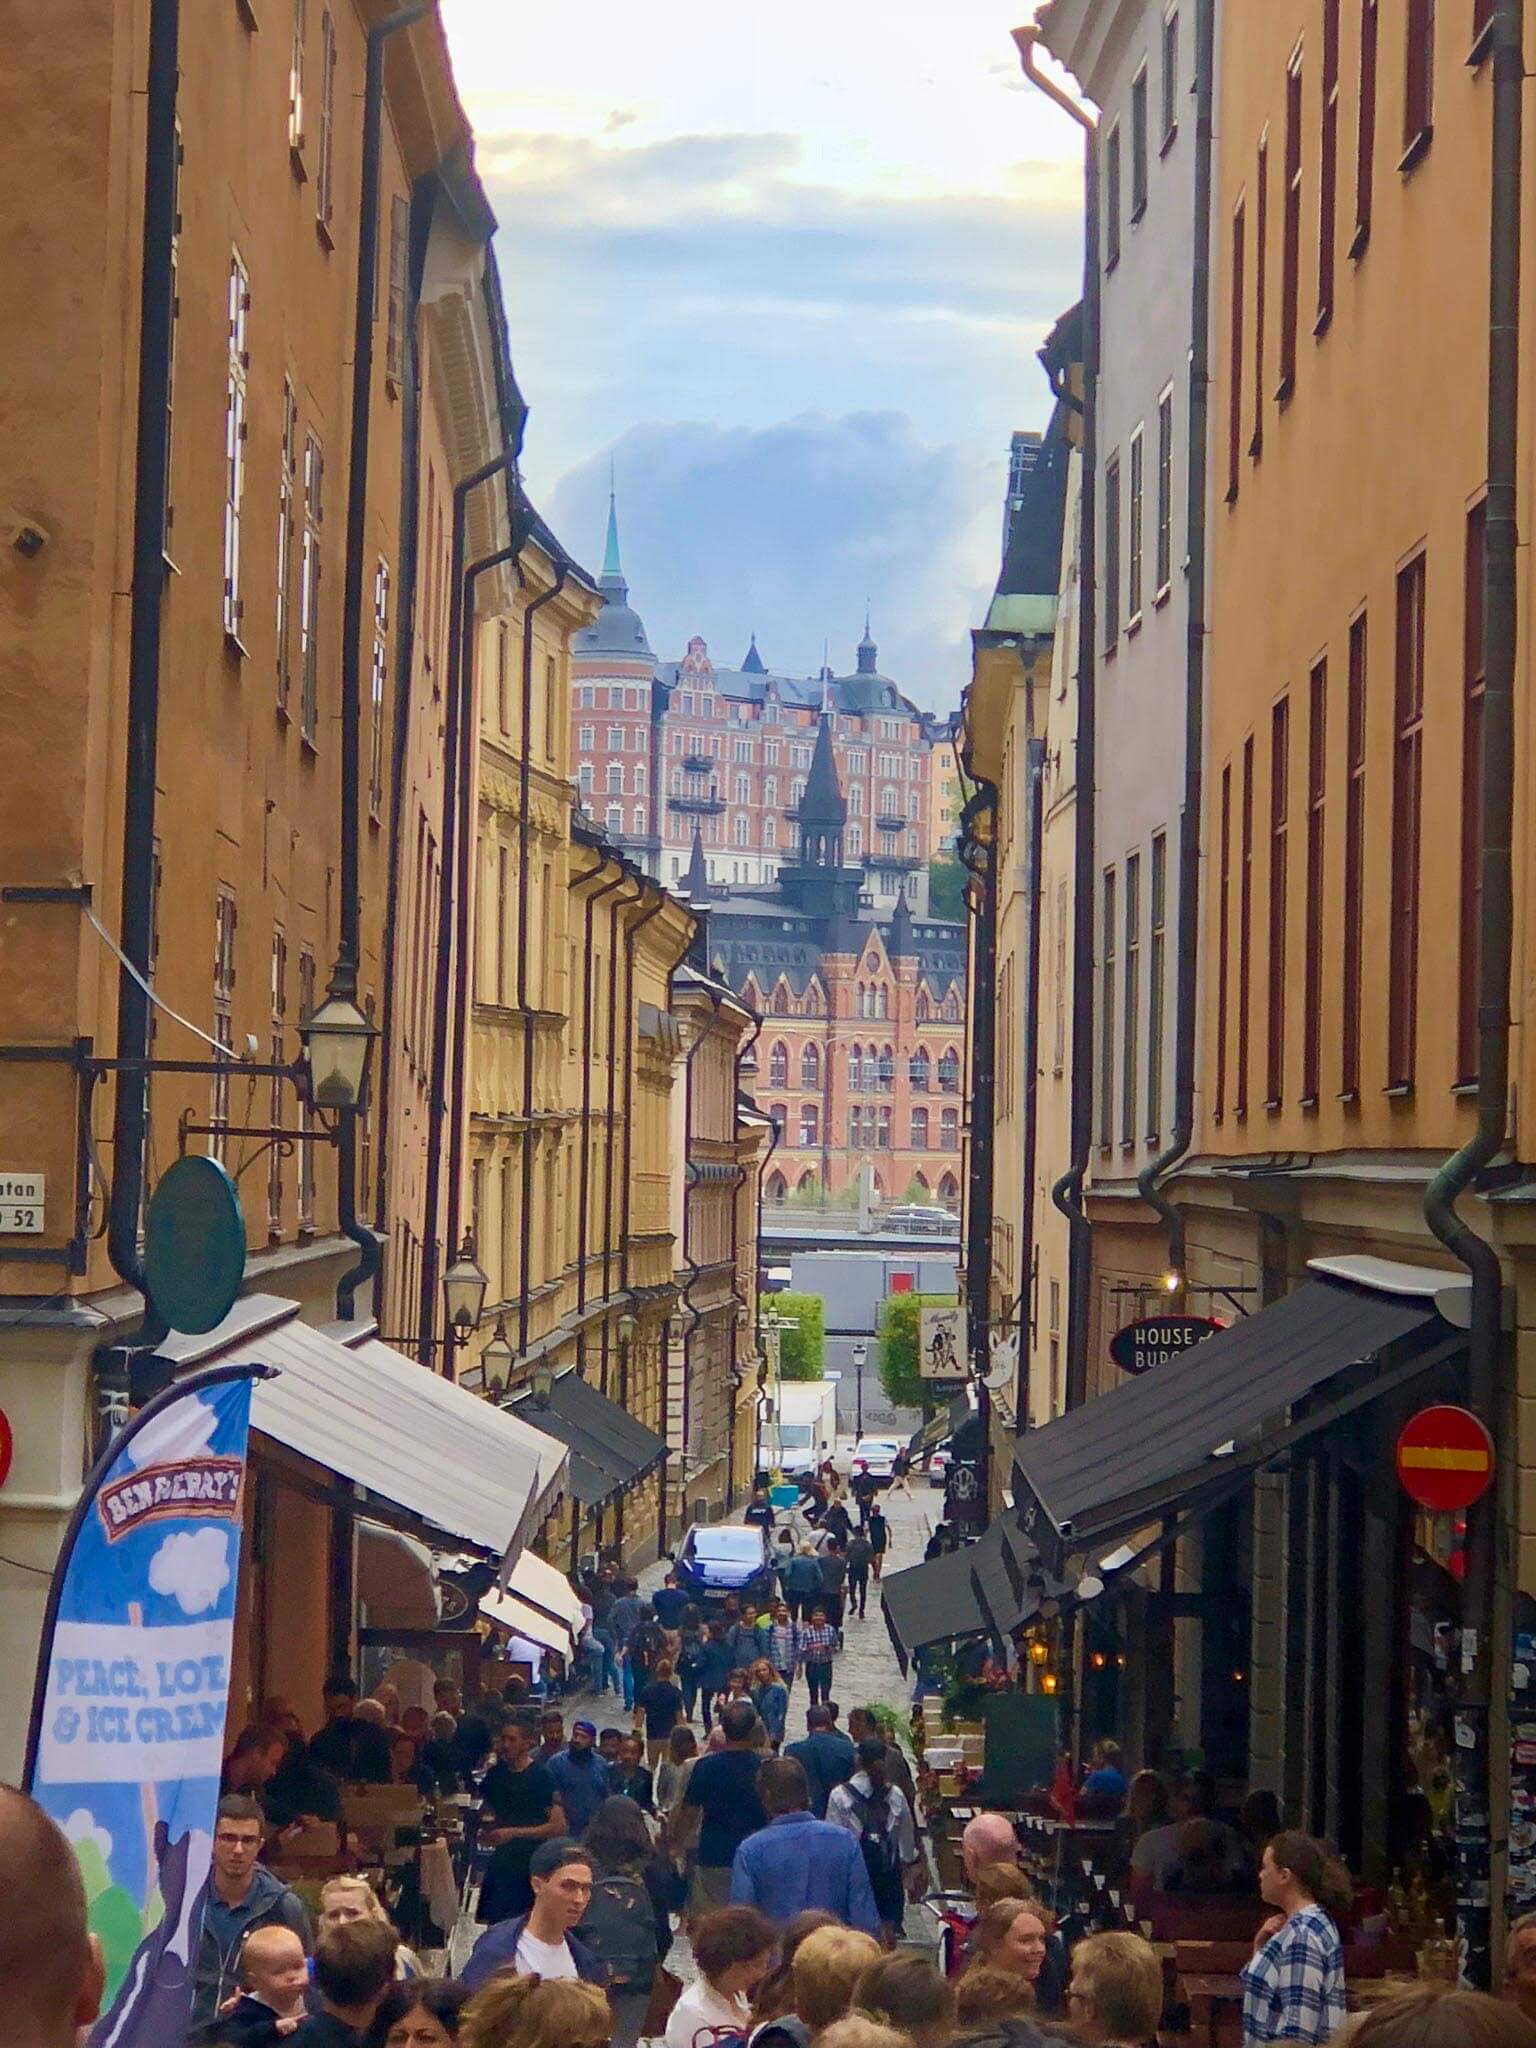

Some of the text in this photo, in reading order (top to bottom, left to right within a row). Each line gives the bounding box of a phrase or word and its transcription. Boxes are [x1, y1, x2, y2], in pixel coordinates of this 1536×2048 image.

[1135, 1328, 1193, 1345] HOUSE
[107, 1481, 153, 1524] BEN
[156, 1655, 226, 1697] LOE
[53, 1706, 80, 1744] &
[87, 1705, 131, 1744] ICE
